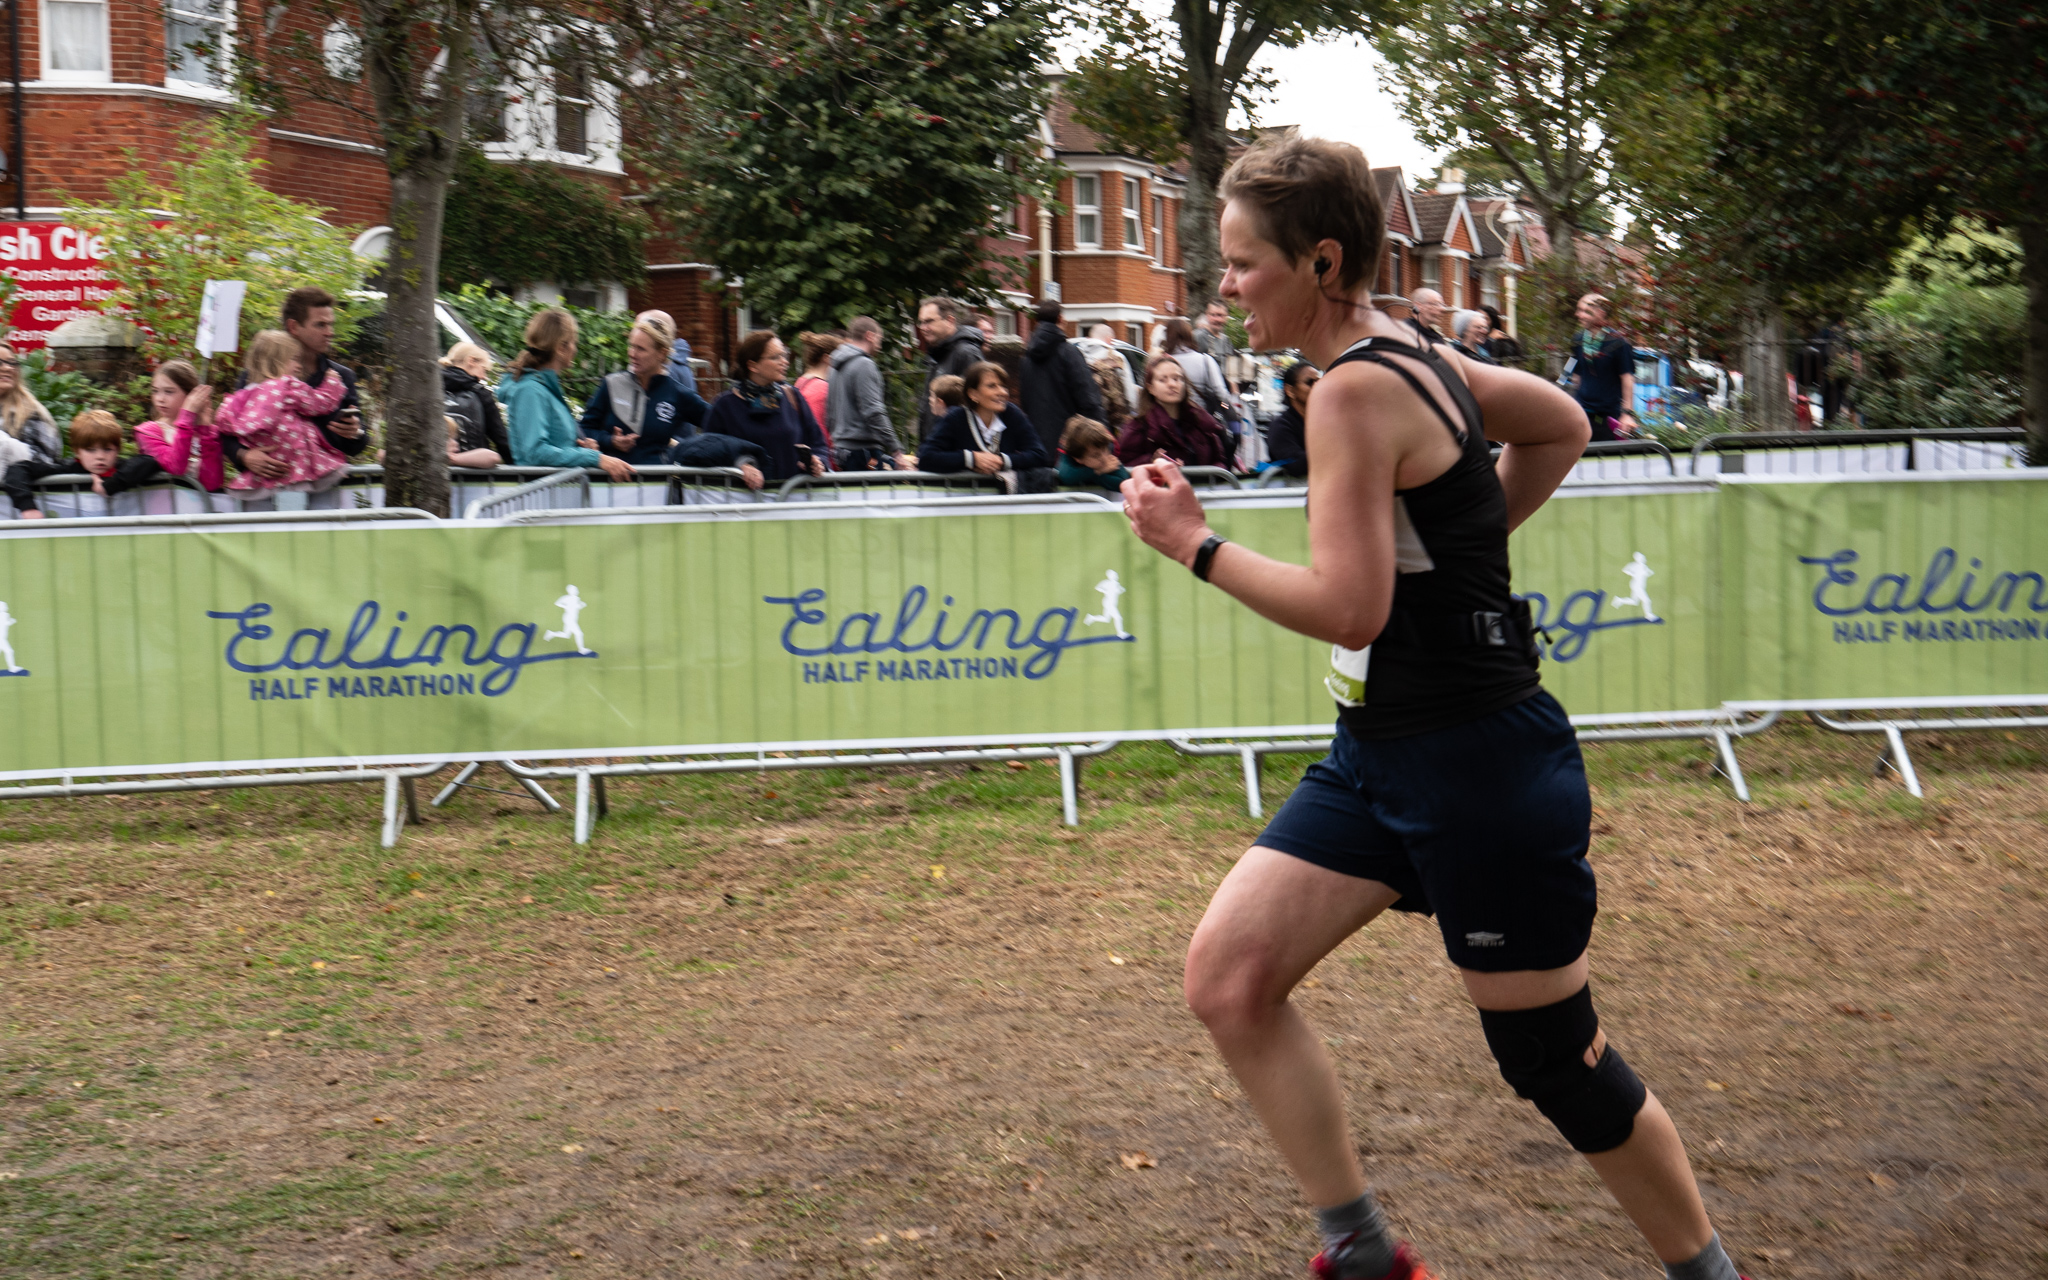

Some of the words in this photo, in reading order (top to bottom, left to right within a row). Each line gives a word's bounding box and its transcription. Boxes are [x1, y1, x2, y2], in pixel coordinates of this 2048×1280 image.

[1797, 546, 2048, 617] Ealin
[205, 599, 599, 698] Ealing
[763, 584, 1137, 681] Ealing
[1833, 620, 1897, 643] HALF
[1903, 618, 2041, 642] MARATHON
[249, 677, 320, 701] HALF
[327, 672, 475, 699] MARATHON
[803, 660, 870, 684] HALF
[876, 656, 1018, 682] MARATHON
